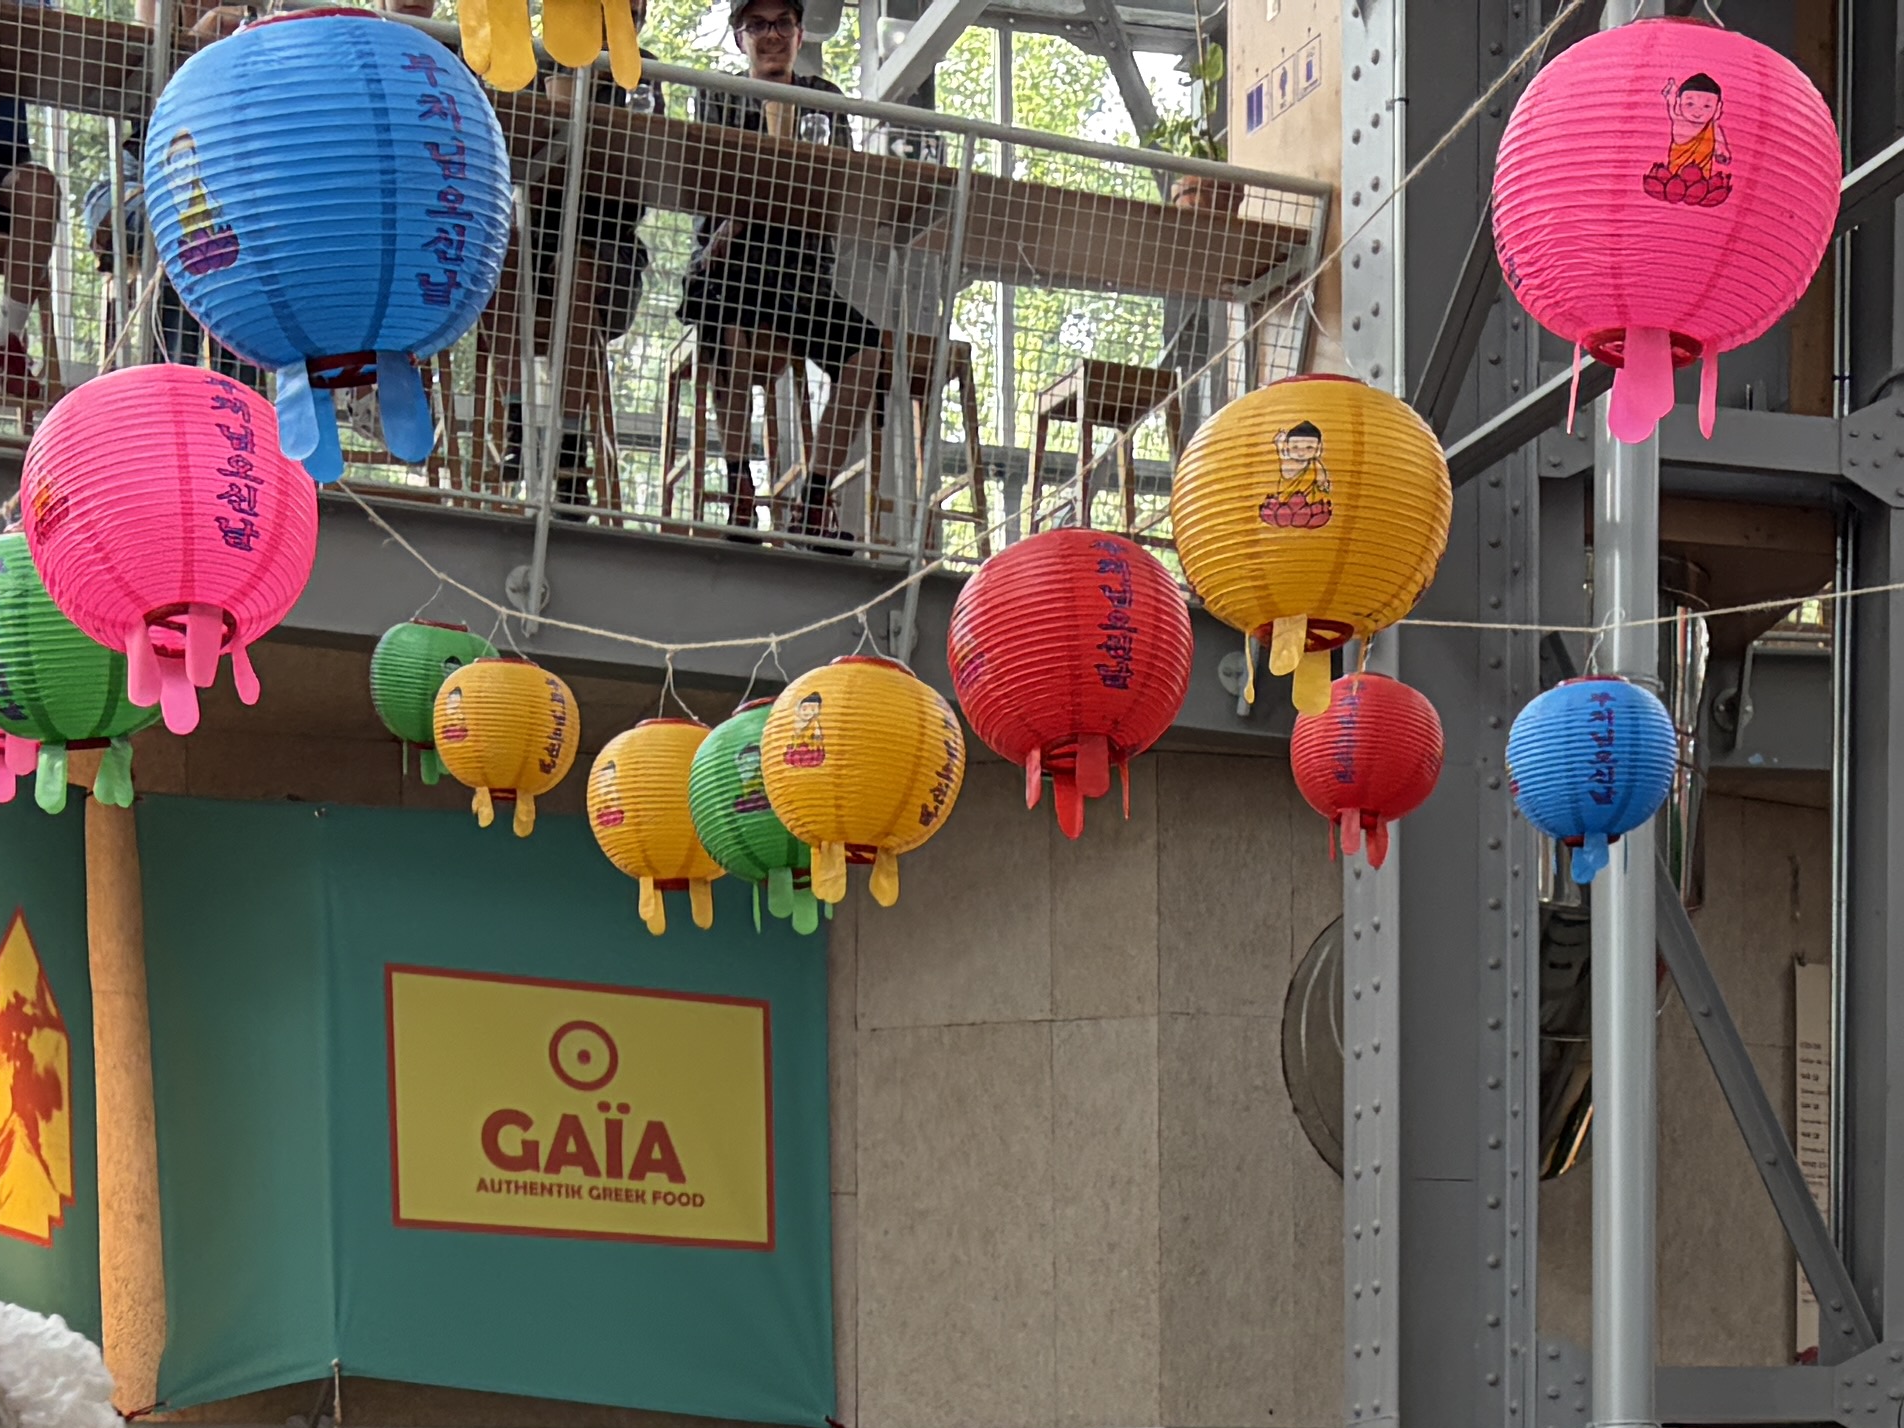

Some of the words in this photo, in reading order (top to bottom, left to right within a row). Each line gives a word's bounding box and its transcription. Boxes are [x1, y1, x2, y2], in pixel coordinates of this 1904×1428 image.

[401, 51, 475, 306] 부처님오신날
[481, 1100, 687, 1185] GAÏA
[476, 1177, 584, 1200] AUTHENTIK
[588, 1185, 648, 1206] GREEK
[652, 1190, 705, 1208] FOOD
